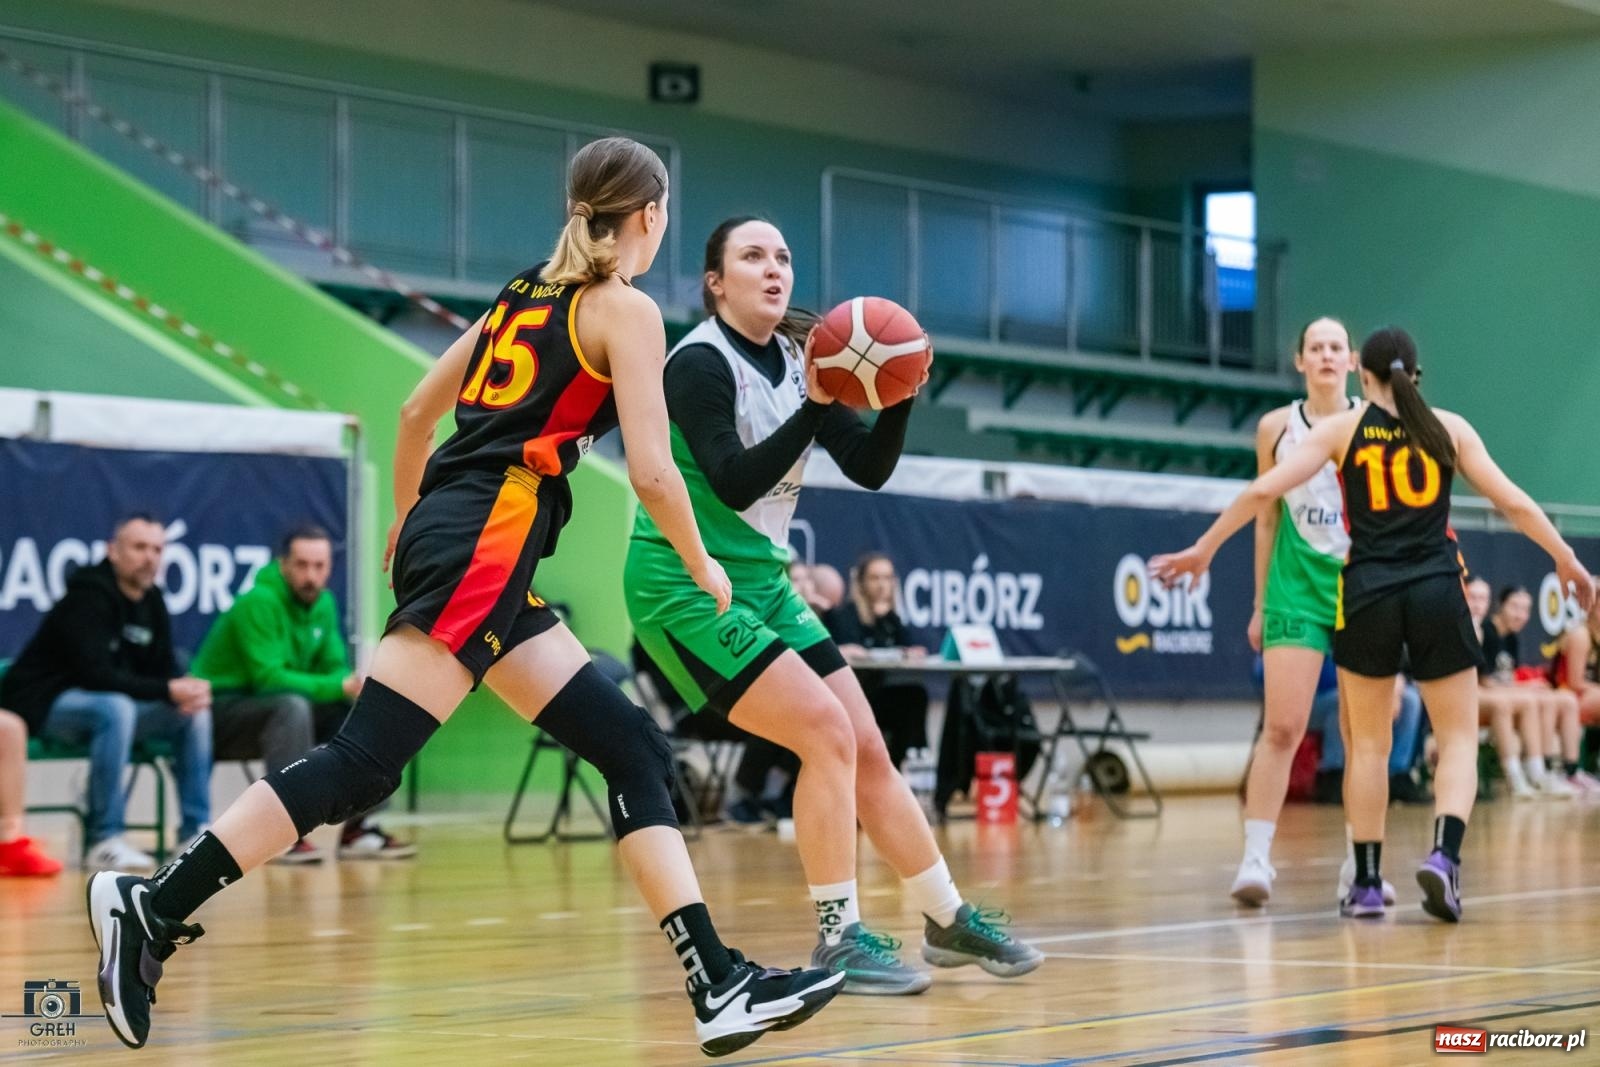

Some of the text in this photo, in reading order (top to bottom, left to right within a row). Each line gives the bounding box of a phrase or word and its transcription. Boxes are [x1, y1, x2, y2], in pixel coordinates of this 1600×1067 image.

[460, 301, 552, 409] 15
[1355, 444, 1441, 511] 10
[1307, 508, 1343, 525] Cla
[983, 758, 1014, 808] 5
